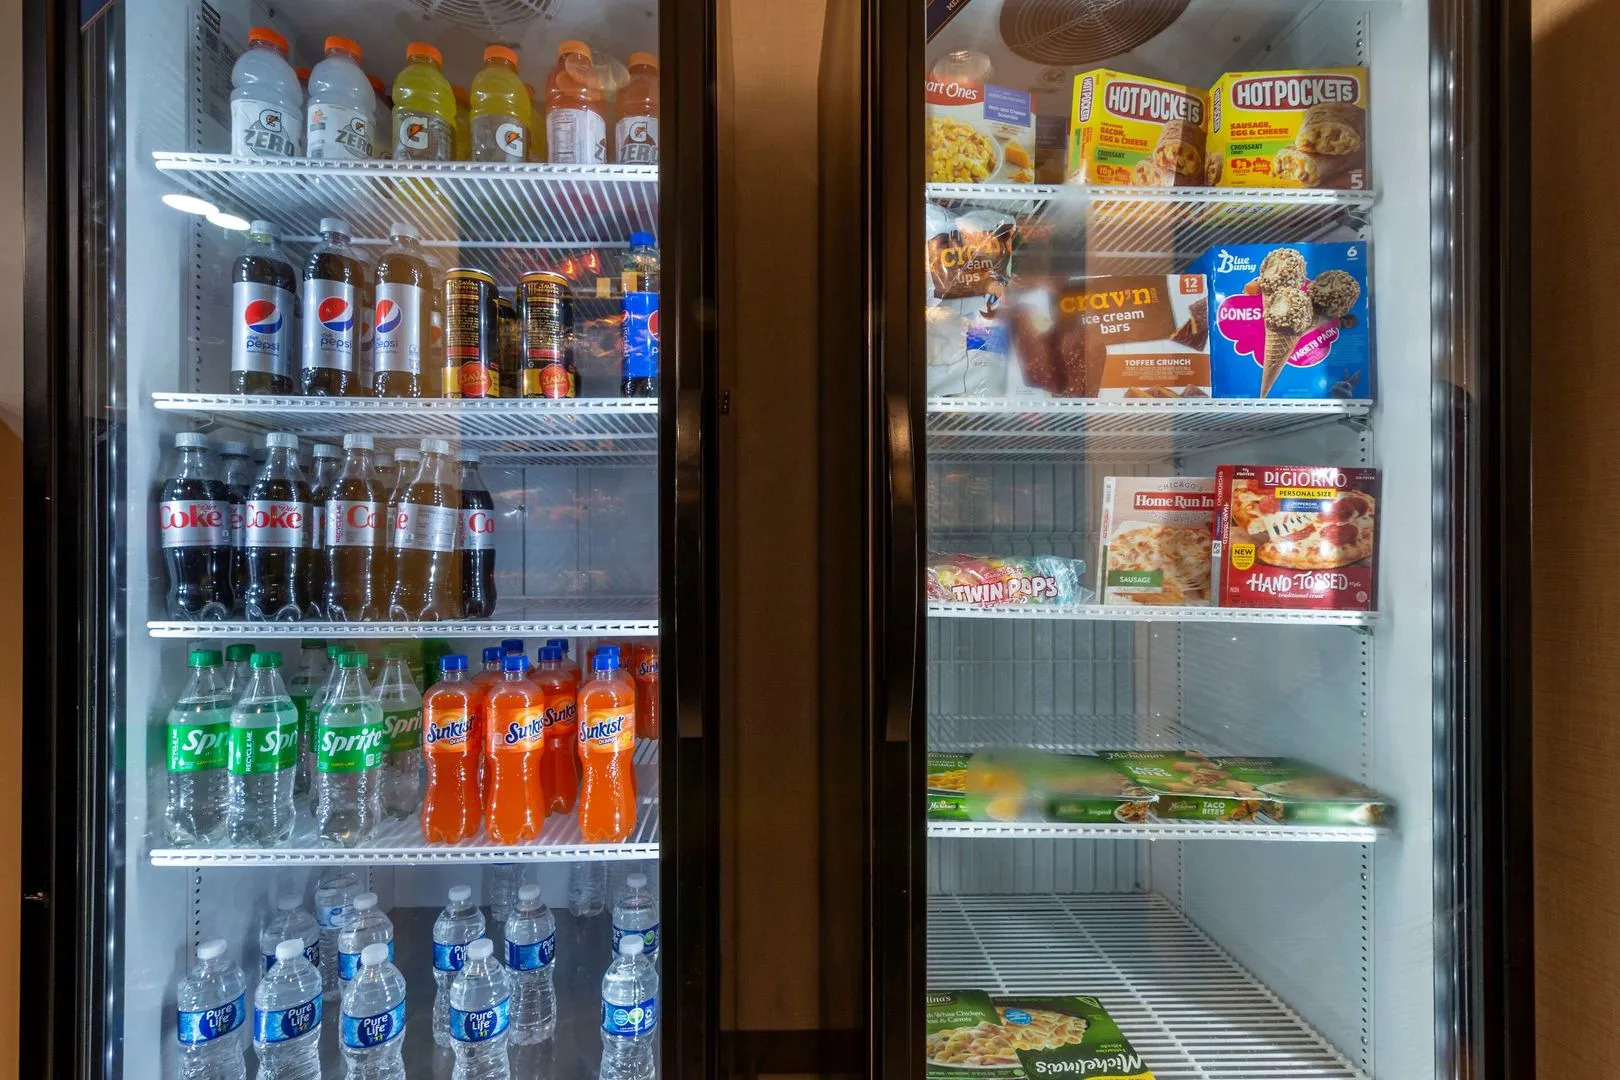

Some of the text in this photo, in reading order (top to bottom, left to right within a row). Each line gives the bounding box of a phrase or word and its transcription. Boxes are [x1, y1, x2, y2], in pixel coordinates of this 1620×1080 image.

[925, 80, 943, 93] art
[946, 82, 978, 100] Ones
[1230, 121, 1272, 129] SAUSAGE,
[1231, 129, 1248, 137] EGG
[1257, 128, 1289, 136] CHEESE
[244, 129, 295, 157] ZERO
[335, 129, 373, 157] ZERO
[1100, 134, 1114, 142] EGG
[1121, 138, 1148, 146] CHEESE
[1230, 143, 1263, 151] CROISSANT
[1350, 174, 1363, 189] 5
[1347, 246, 1358, 257] 6
[966, 259, 993, 270] eam
[957, 271, 980, 286] ups
[1184, 277, 1198, 288] 12
[1060, 287, 1151, 313] crav'n
[1081, 309, 1145, 325] ice cream
[1219, 307, 1262, 321] CONES
[1100, 322, 1131, 335] bars
[247, 340, 280, 352] pepsi
[320, 337, 352, 350] pepsi
[1290, 339, 1320, 362] VARIETY
[1316, 327, 1338, 344] PACK
[1125, 359, 1155, 367] TOFFEE
[1316, 490, 1332, 498] SIZE
[280, 503, 298, 512] Diet
[1135, 495, 1174, 507] Home
[1174, 495, 1201, 509] Run
[160, 504, 224, 530] Coke
[244, 504, 303, 529] Coke
[468, 512, 495, 534] Co
[951, 576, 1058, 604] TWIN POPS
[1246, 570, 1348, 595] HAND-TOSSED
[427, 715, 476, 744] Sunkist
[579, 716, 625, 743] Sunkist
[321, 728, 382, 757] Sprite
[1202, 808, 1225, 816] BITES
[1203, 801, 1226, 809] TACO
[206, 1004, 233, 1021] Pure
[288, 1002, 313, 1019] Pure
[469, 1010, 494, 1025] Pure
[209, 1015, 230, 1029] Life
[291, 1013, 311, 1028] Life
[363, 1014, 389, 1030] Pure
[472, 1019, 491, 1034] Life
[366, 1024, 387, 1037] Life
[1036, 1053, 1142, 1074] Michelina's
